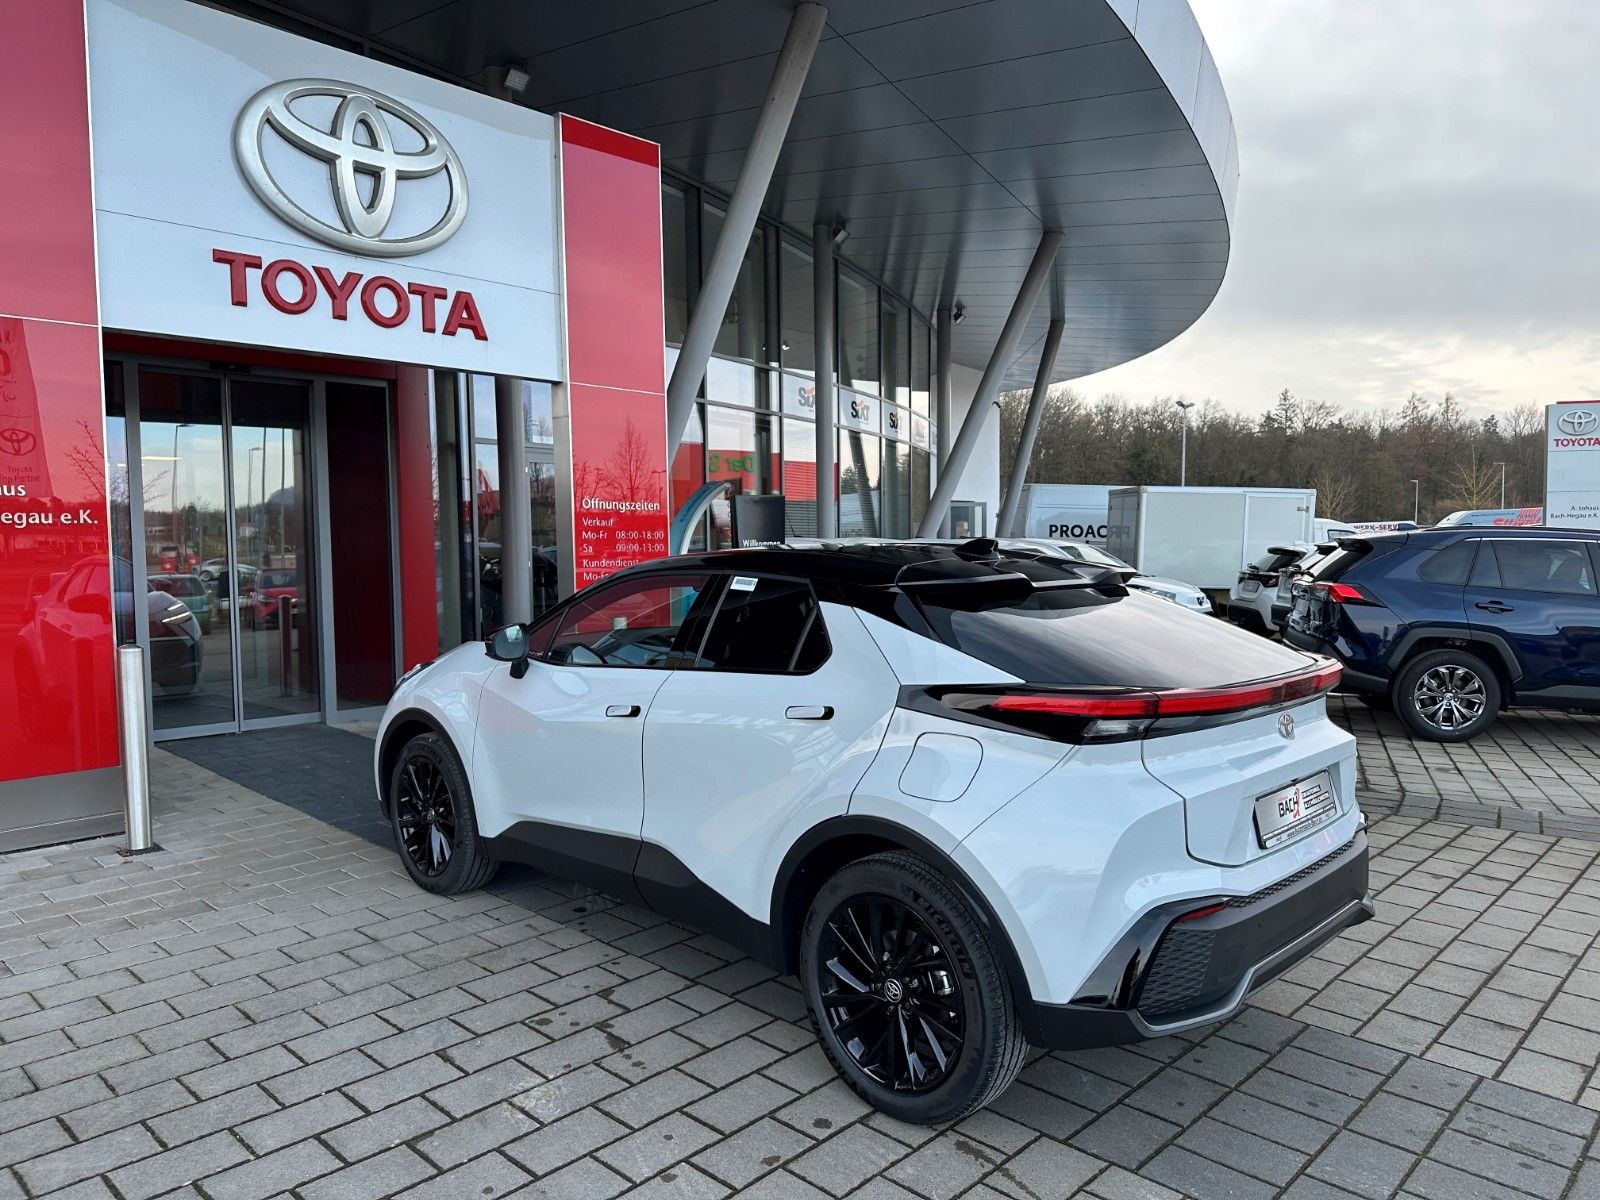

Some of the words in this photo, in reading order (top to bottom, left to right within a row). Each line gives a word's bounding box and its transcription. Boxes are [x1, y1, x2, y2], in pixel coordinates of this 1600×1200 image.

[212, 248, 488, 341] TOYOTA
[1554, 438, 1600, 447] TOYOTA
[582, 496, 660, 512] Öffnungszeiten
[60, 509, 99, 524] e.K.
[582, 517, 613, 526] Verkauf
[582, 531, 607, 540] Mo-Fr
[615, 530, 665, 540] 08:00-18:00
[583, 543, 593, 553] Sa
[615, 543, 665, 553] 09:00-13:00
